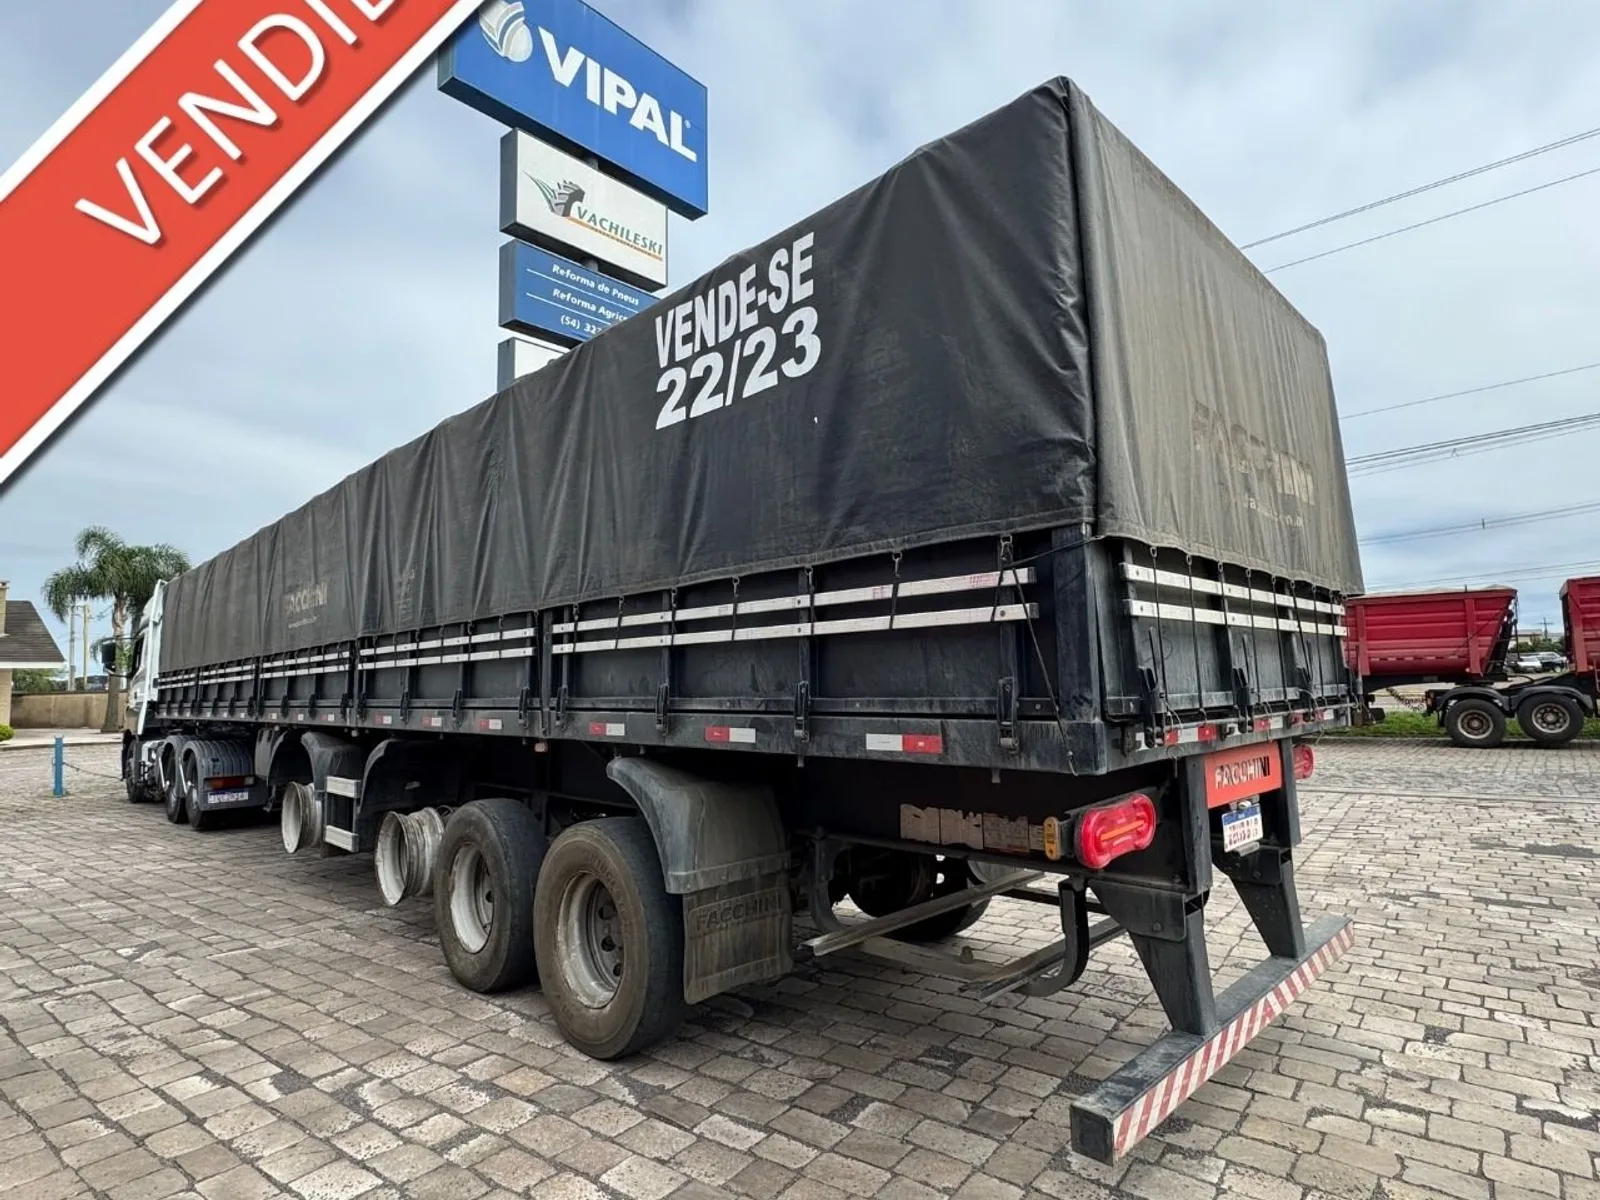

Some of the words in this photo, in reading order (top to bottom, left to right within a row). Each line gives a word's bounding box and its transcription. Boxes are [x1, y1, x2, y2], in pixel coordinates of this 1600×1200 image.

[538, 26, 698, 163] VIPAL
[577, 206, 663, 256] VACHILESKI
[552, 264, 595, 289] Reforma
[597, 282, 610, 294] de
[612, 288, 640, 306] Pneus
[552, 288, 597, 312] Reforma
[655, 231, 815, 369] VENDE-SE
[560, 315, 581, 330] (54)
[655, 306, 821, 430] 22/23
[1215, 755, 1271, 790] FACCHINI
[696, 894, 783, 931] FACCHINI
